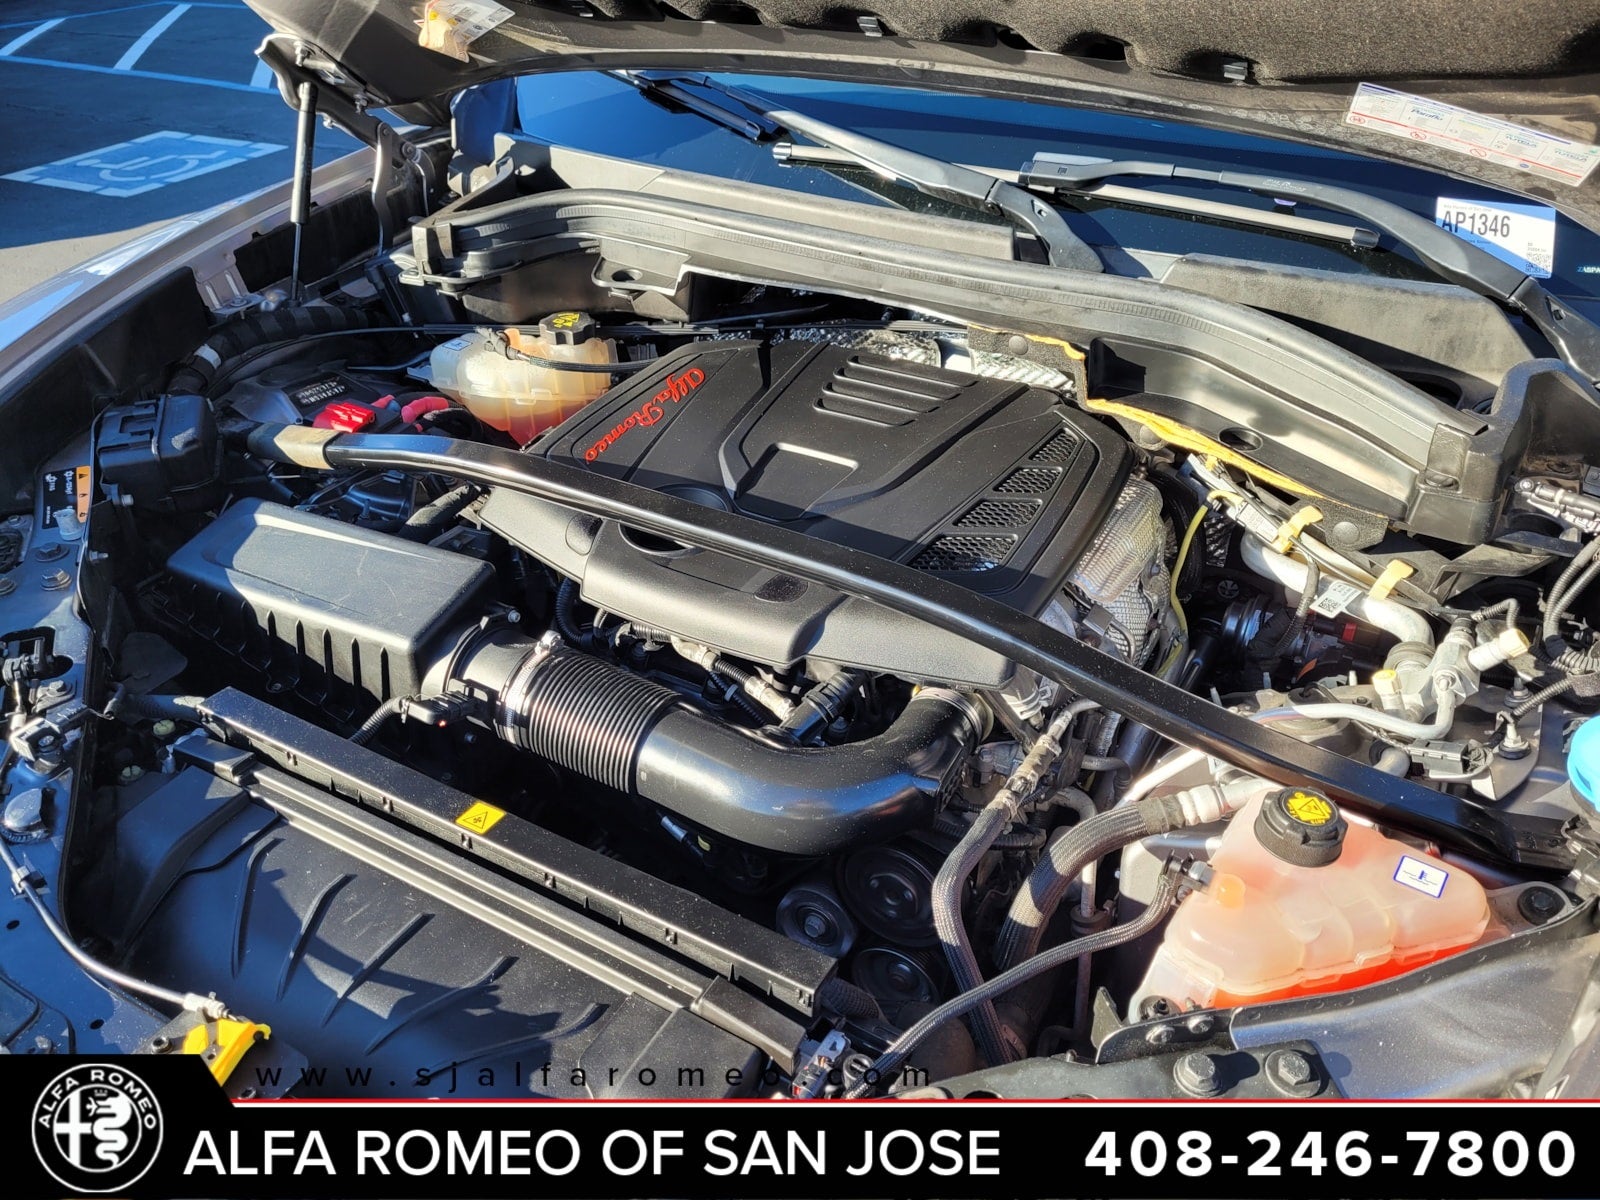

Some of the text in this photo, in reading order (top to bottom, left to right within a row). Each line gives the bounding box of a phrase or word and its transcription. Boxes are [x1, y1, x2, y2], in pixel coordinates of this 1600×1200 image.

[1441, 210, 1512, 238] AP1346
[584, 367, 705, 462] Alfa Romeo
